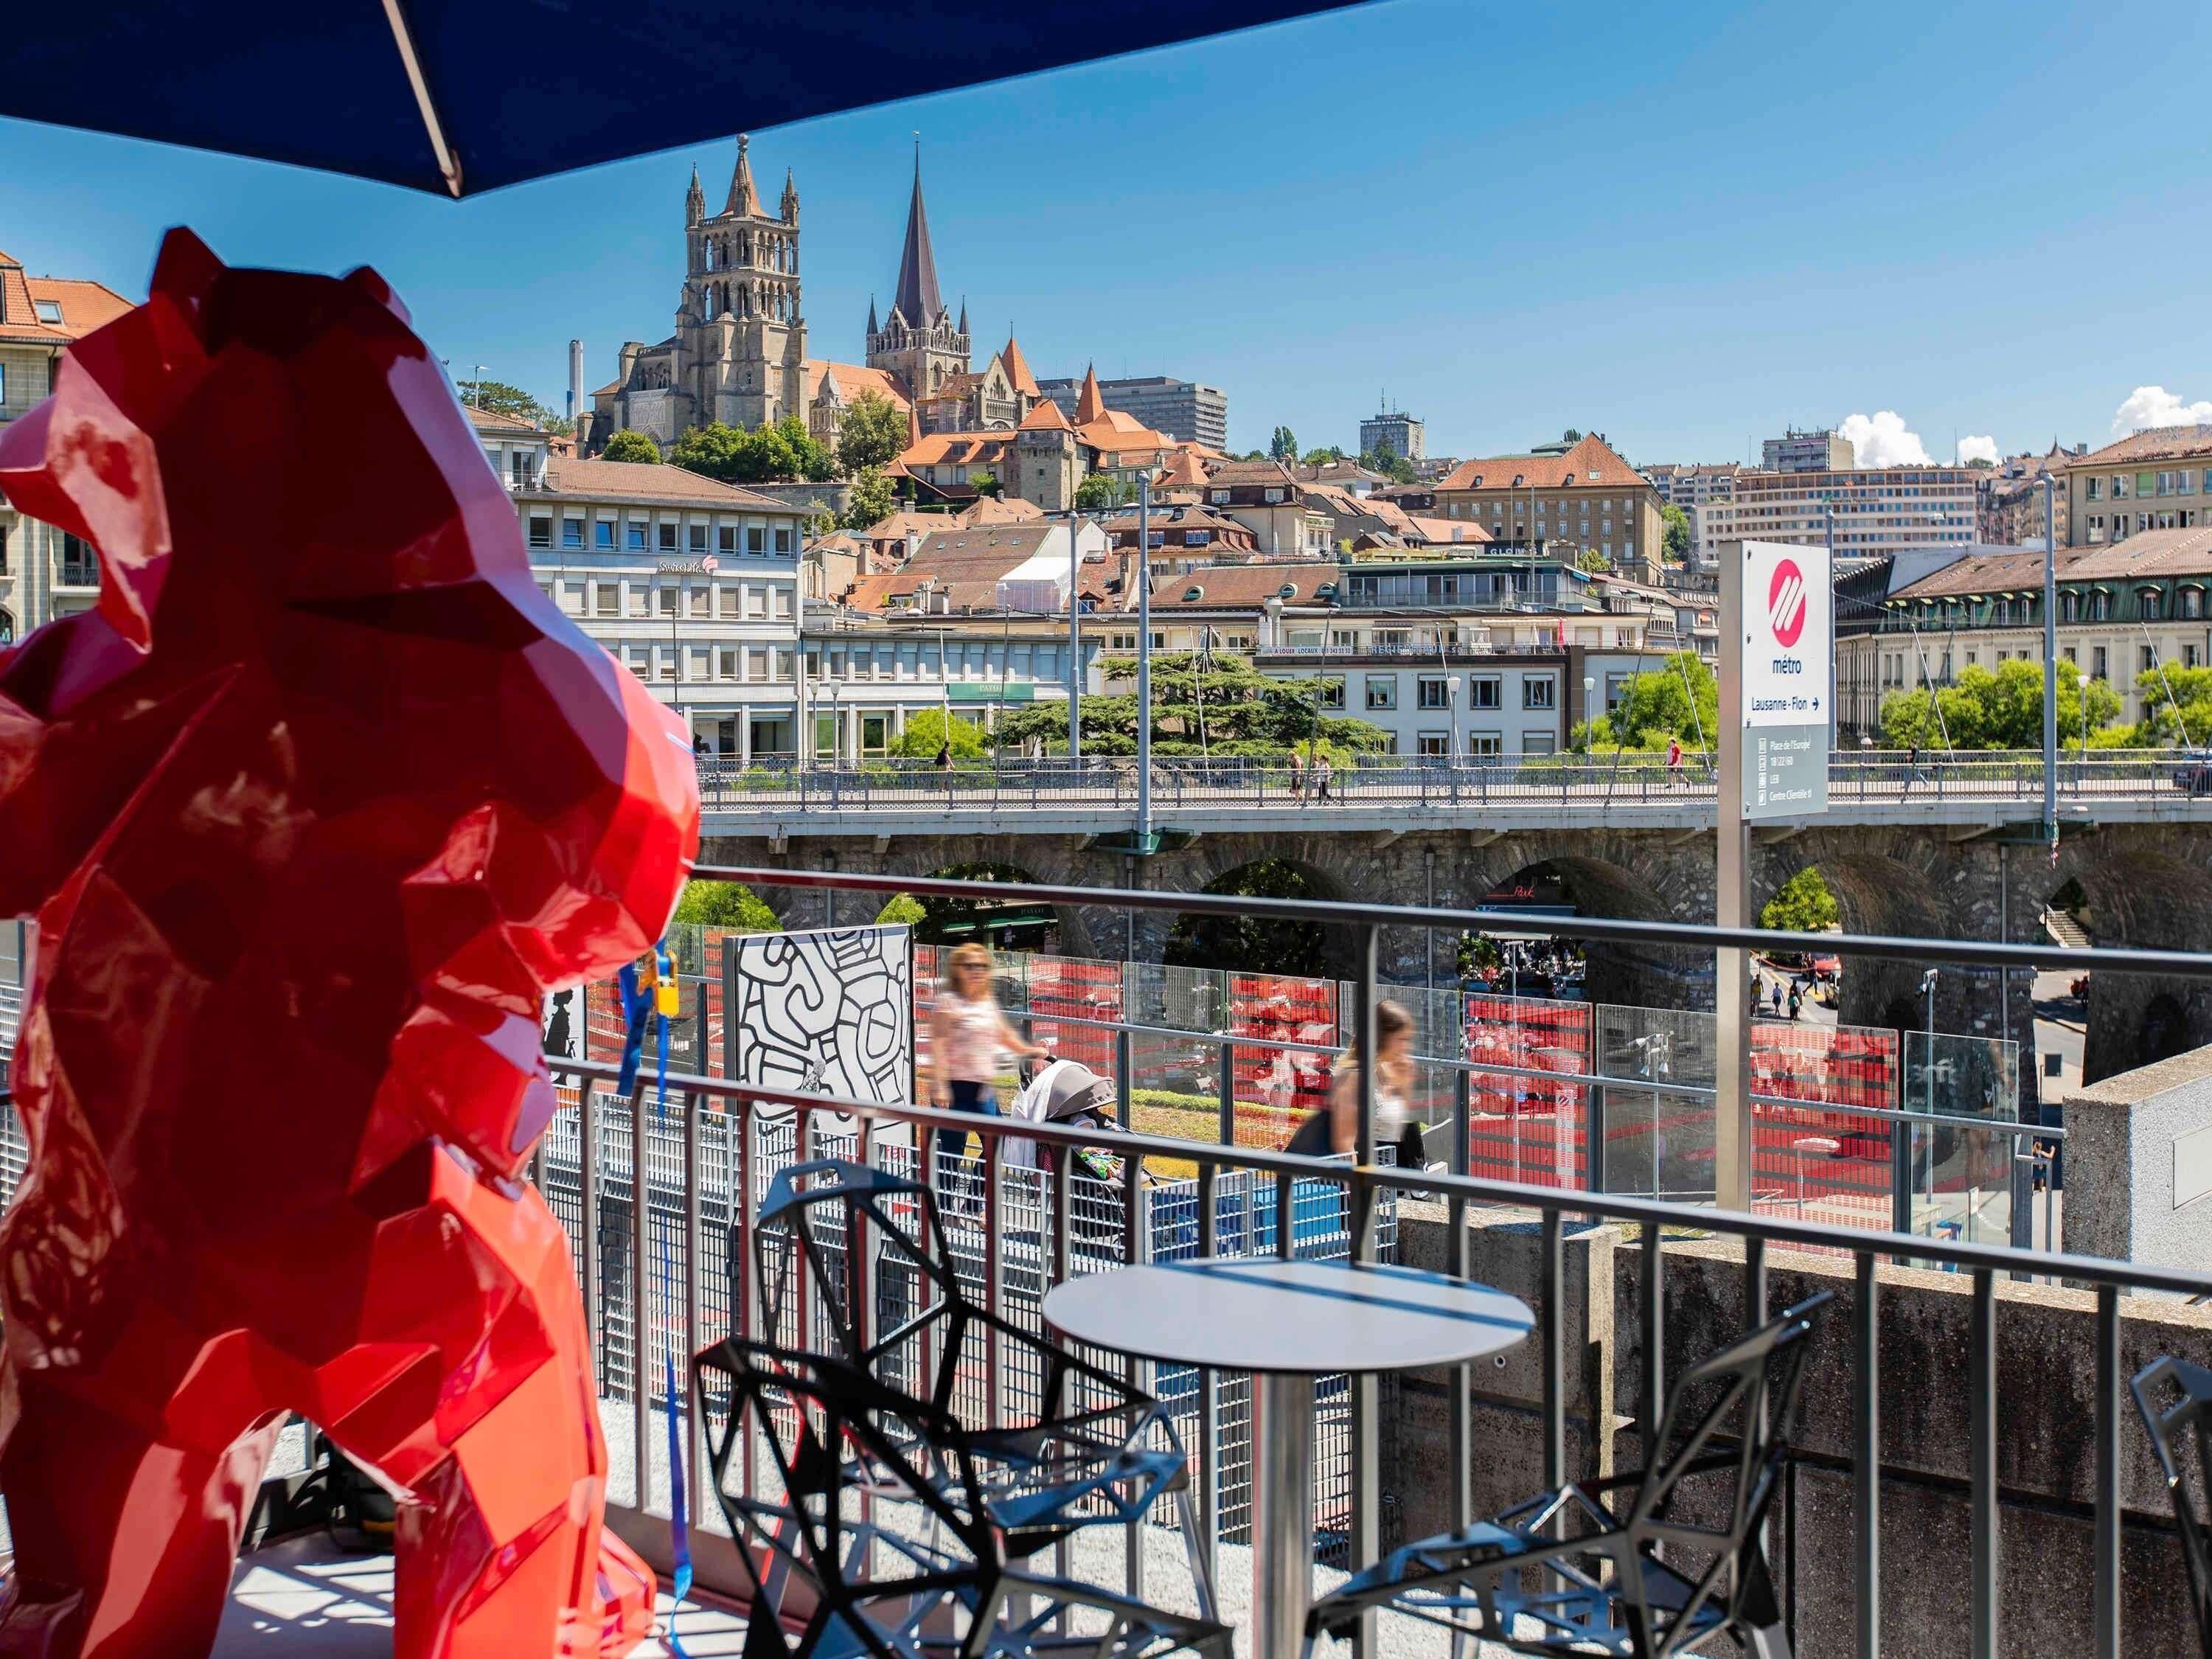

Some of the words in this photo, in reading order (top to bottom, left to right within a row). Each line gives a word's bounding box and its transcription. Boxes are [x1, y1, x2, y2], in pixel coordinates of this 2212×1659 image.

[1773, 654, 1801, 674] métro
[1751, 696, 1787, 711] Lausanne
[1792, 696, 1807, 710] Flon
[1770, 740, 1783, 750] Place
[1784, 740, 1790, 749] de
